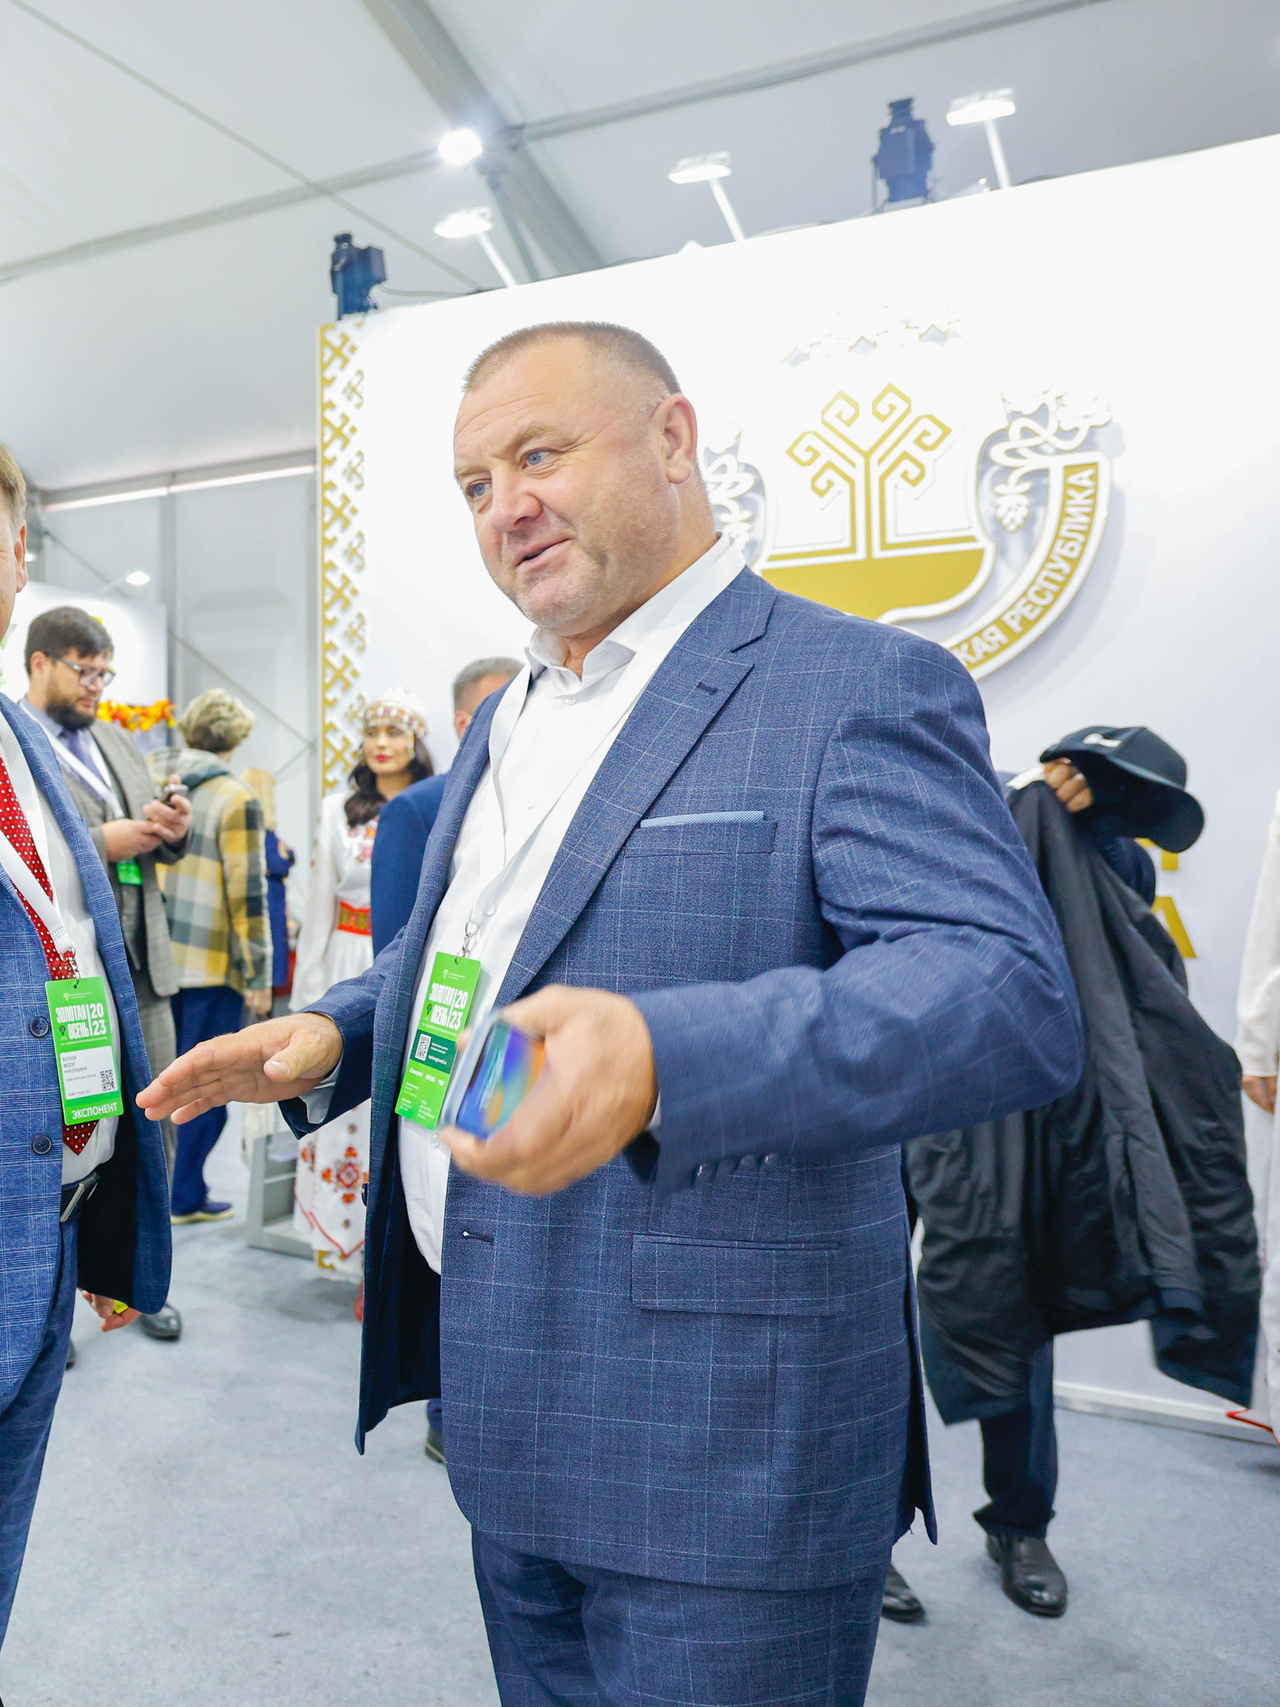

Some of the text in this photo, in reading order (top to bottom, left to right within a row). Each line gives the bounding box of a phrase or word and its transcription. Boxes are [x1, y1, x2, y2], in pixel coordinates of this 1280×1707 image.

[1000, 468, 1096, 633] РЕСПУБЛИКА
[429, 982, 468, 1009] ЗОЛОТАЯ 20
[55, 1003, 105, 1023] ЗОЛОТАЯ 20
[430, 1004, 449, 1027] ОСЕНЬ
[449, 1010, 464, 1031] 23
[67, 1019, 107, 1039] ОСЕНЬ 23
[71, 1102, 118, 1120] ЭКСПОНЕНТ
